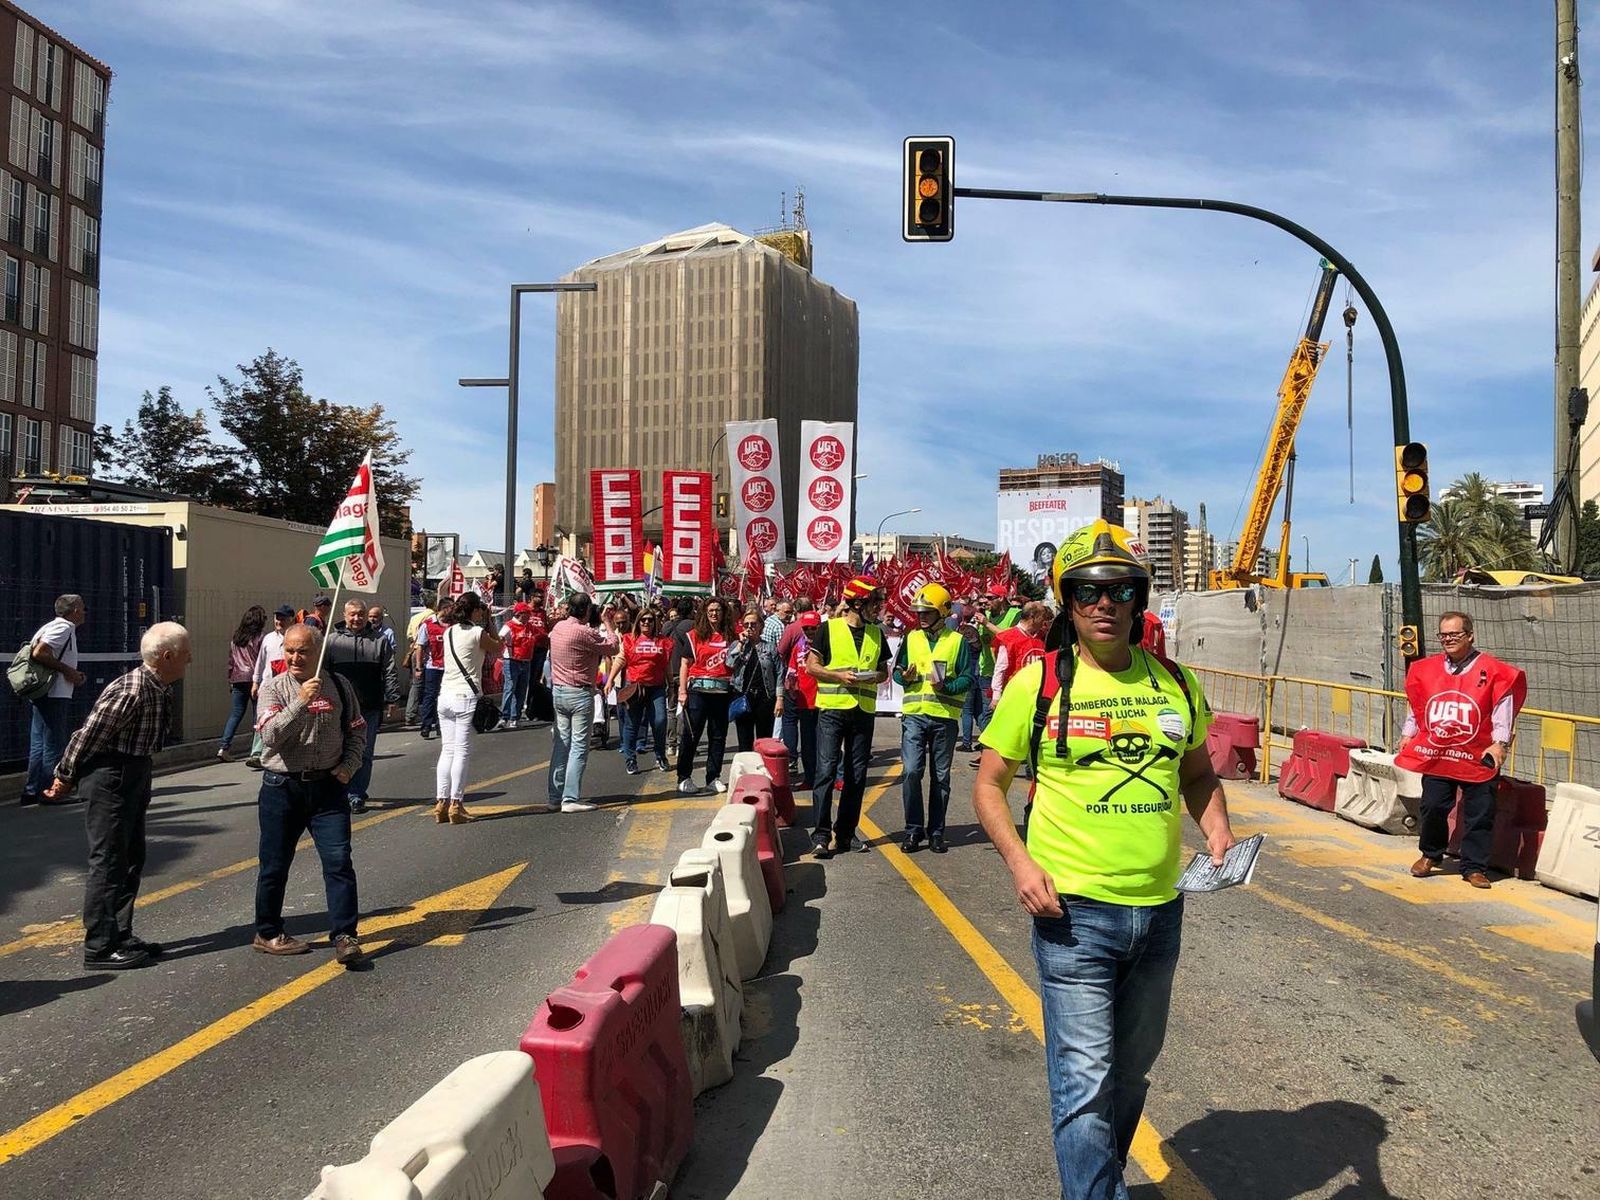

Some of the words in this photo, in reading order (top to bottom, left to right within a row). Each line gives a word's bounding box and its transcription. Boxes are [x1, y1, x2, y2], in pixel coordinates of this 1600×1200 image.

[745, 440, 764, 454] UGT
[817, 440, 837, 454] UGT
[748, 481, 767, 495] UGT
[815, 481, 836, 494] UGT
[1029, 499, 1067, 512] BEEFEATER
[752, 522, 770, 537] UGT
[814, 521, 835, 534] UGT
[1068, 698, 1119, 711] BOMBEROS
[1121, 696, 1133, 706] DE
[1100, 711, 1113, 719] EN
[1116, 708, 1147, 719] LUCHA
[1428, 700, 1473, 726] UGT
[1413, 745, 1439, 756] mano
[1445, 748, 1474, 760] mano
[1086, 804, 1109, 814] POR
[1112, 804, 1127, 814] TU
